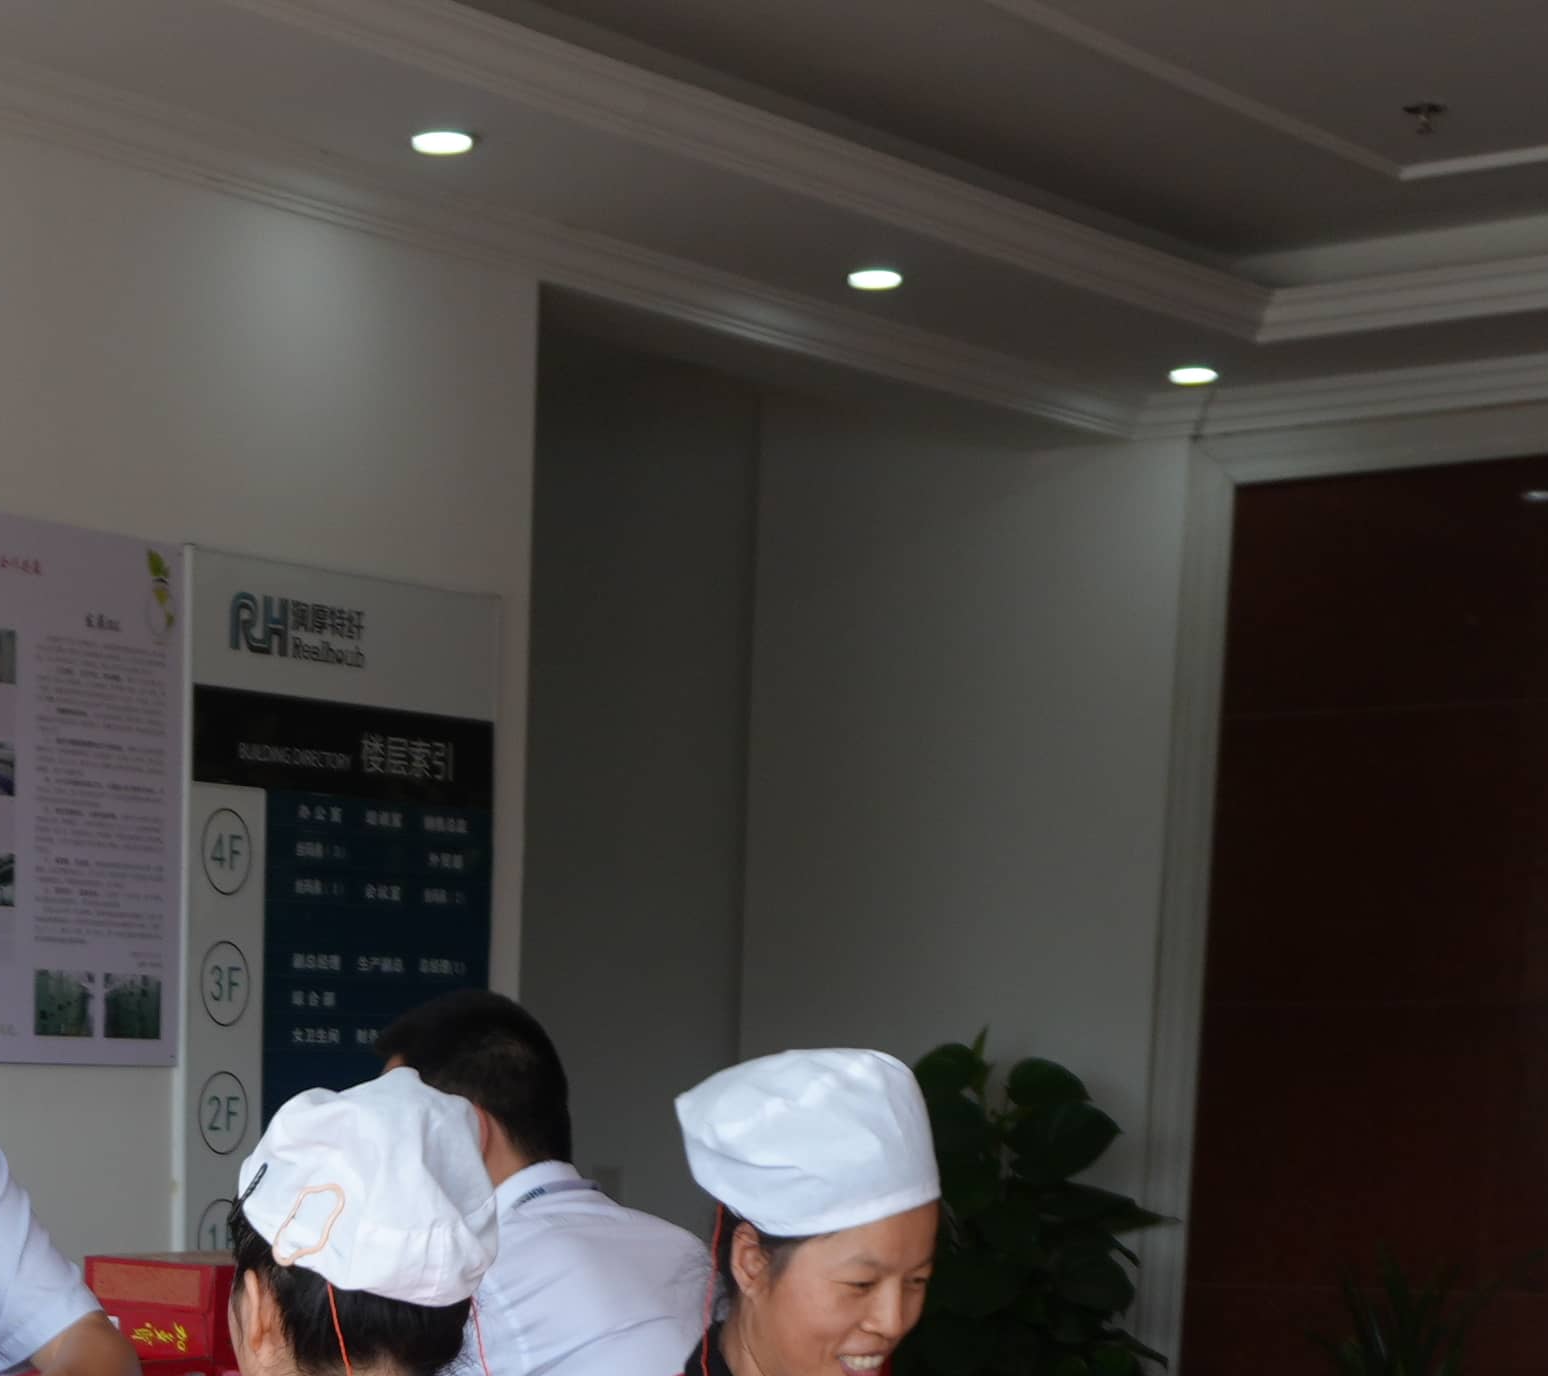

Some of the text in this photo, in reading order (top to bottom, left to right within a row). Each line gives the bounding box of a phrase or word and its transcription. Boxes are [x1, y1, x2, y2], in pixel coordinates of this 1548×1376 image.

[361, 731, 455, 781] 楼层索引
[210, 832, 243, 871] 4F
[210, 964, 241, 1002] 3F
[207, 1095, 240, 1131] 2F
